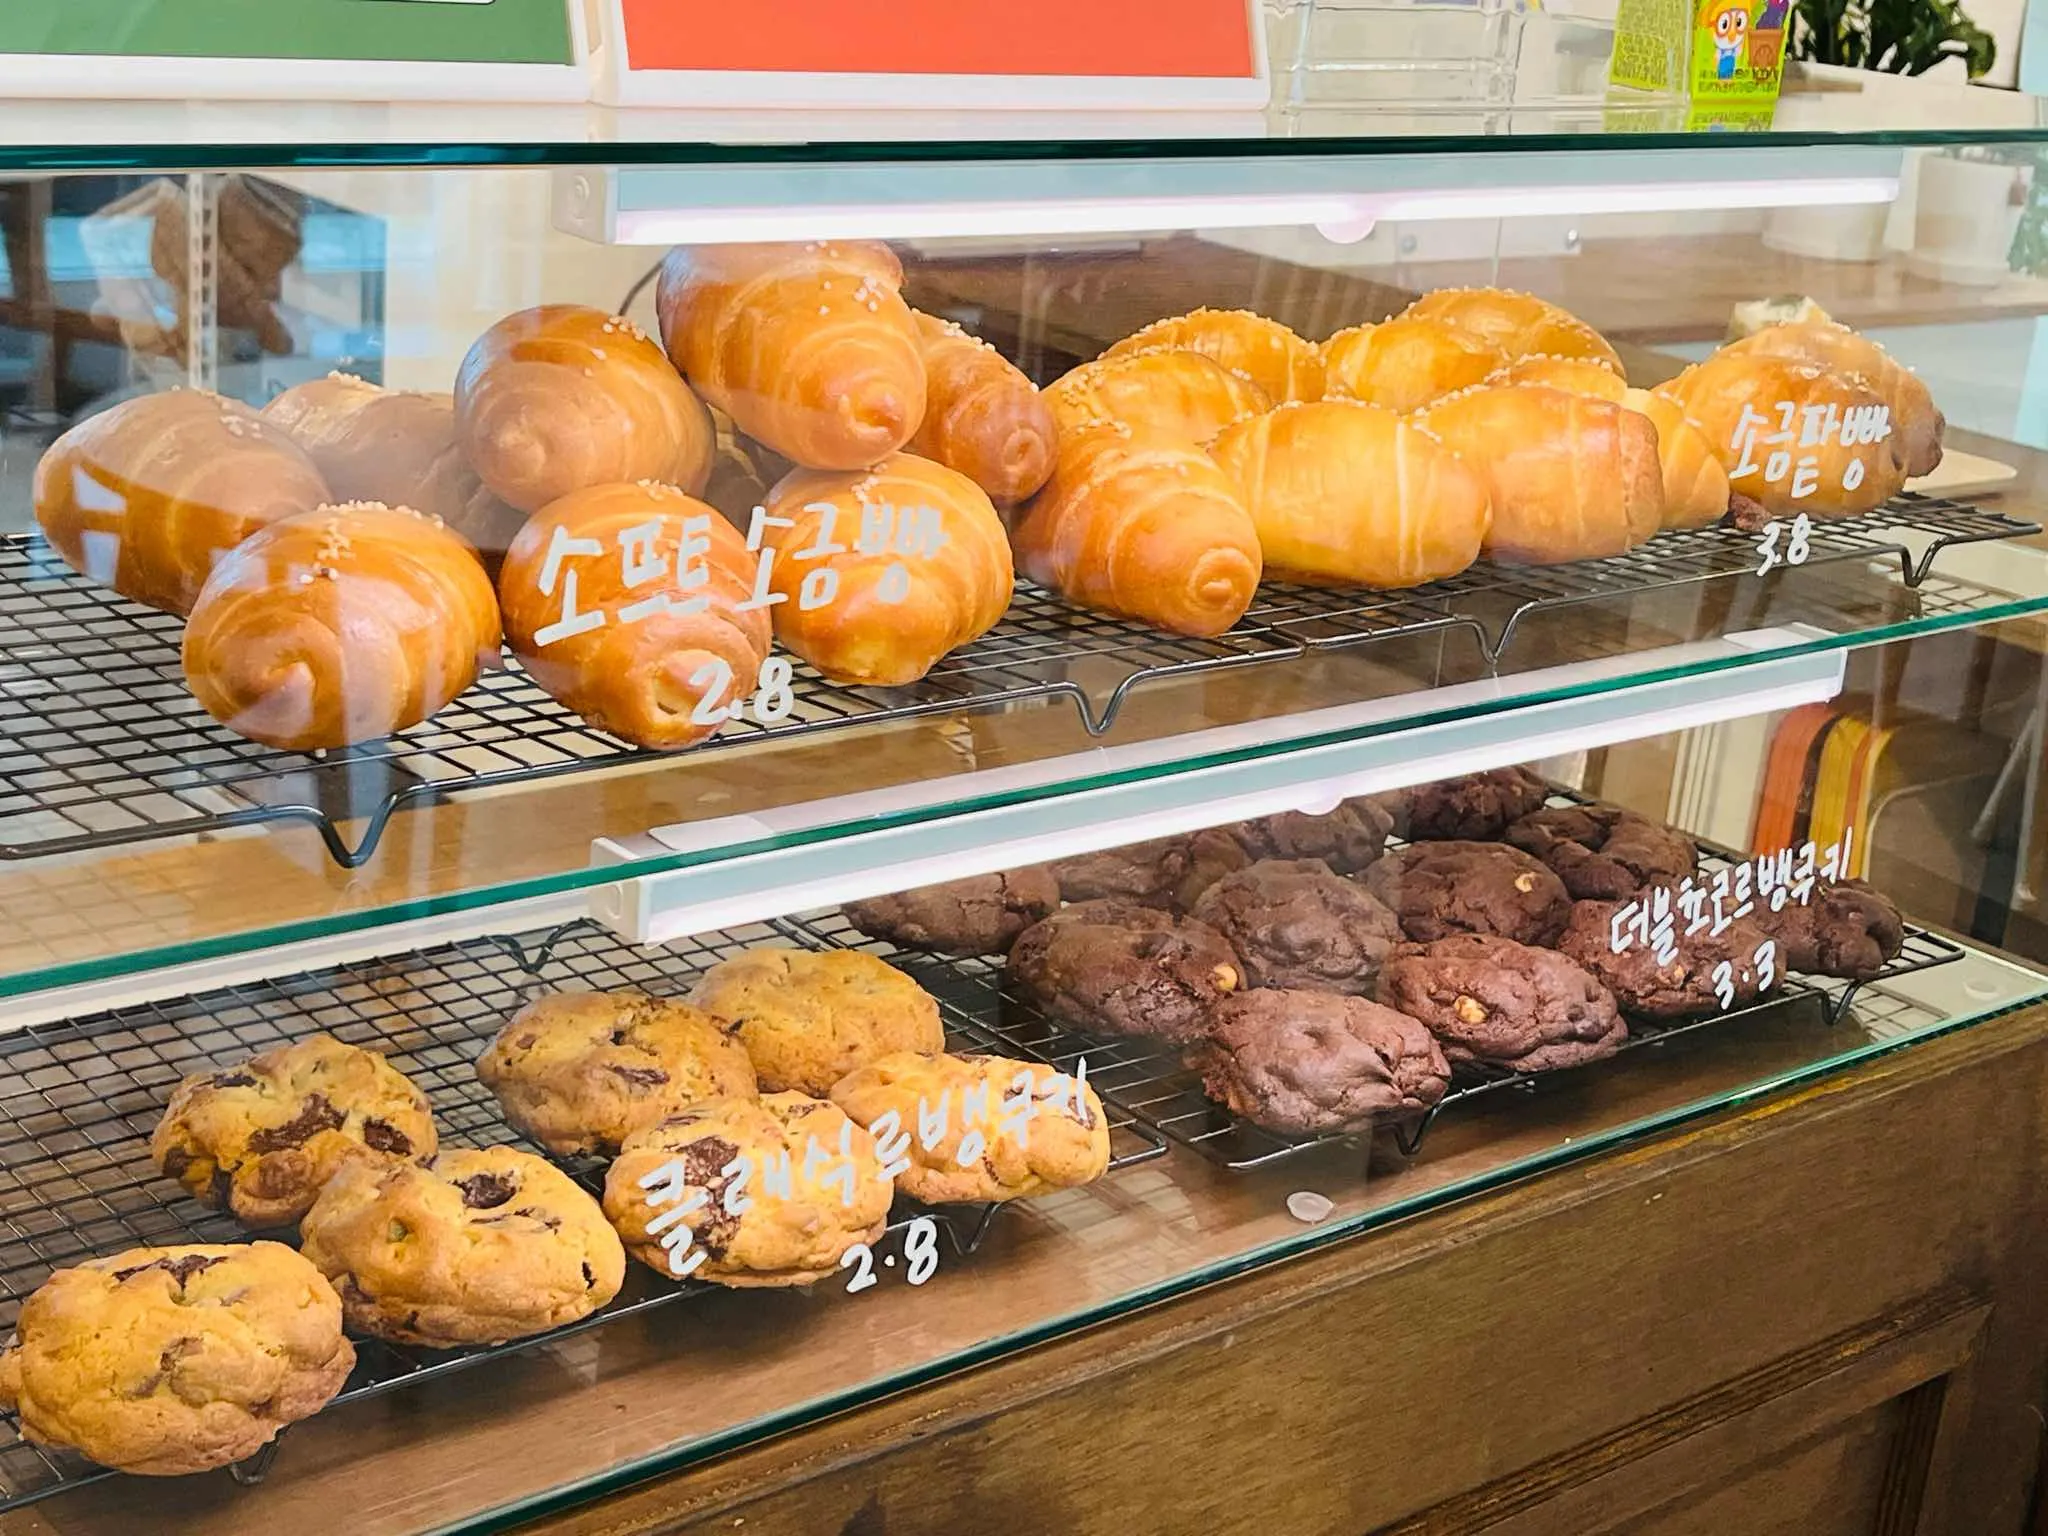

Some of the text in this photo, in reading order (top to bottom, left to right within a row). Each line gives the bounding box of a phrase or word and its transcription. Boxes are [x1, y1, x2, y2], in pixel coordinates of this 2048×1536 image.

[1729, 400, 1892, 498] 소금팥빵
[1756, 512, 1812, 577] 3.8
[688, 656, 795, 726] 2.8
[1711, 939, 1776, 1011] 3.3
[840, 1216, 939, 1293] 2.8
